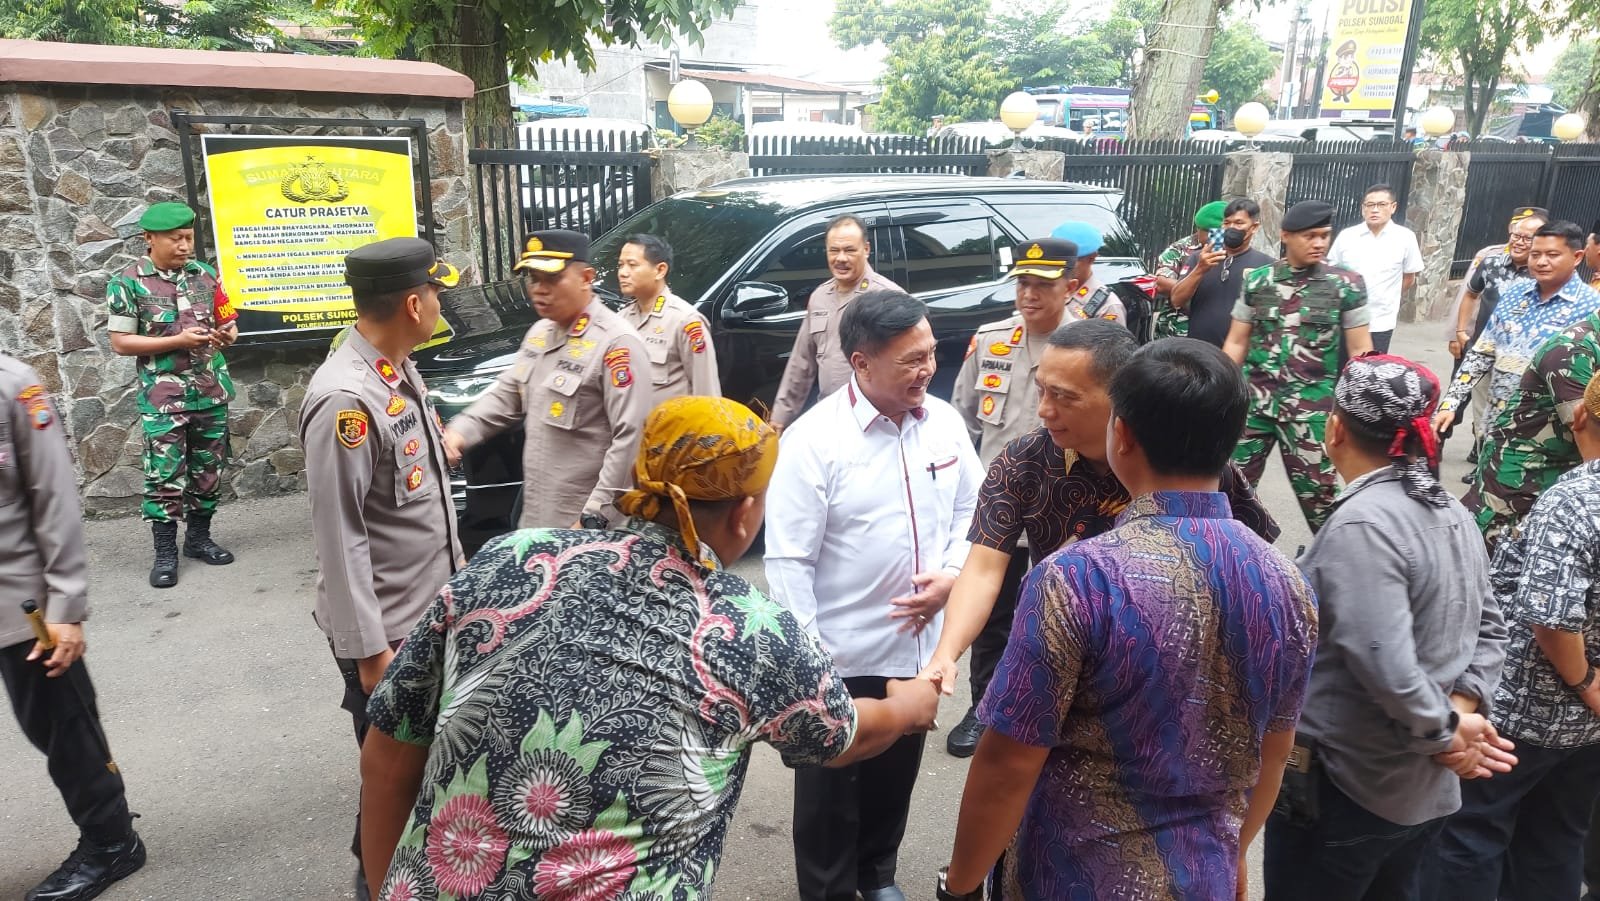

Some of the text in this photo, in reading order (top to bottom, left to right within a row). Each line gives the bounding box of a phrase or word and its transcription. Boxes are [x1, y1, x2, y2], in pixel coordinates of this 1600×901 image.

[1338, 16, 1404, 27] POLSEK SUNGGAL
[265, 206, 369, 218] CATUR PRASETYA
[282, 310, 358, 323] POLSEK SUNG
[646, 337, 667, 346] POLRI
[556, 360, 584, 374] POLRI
